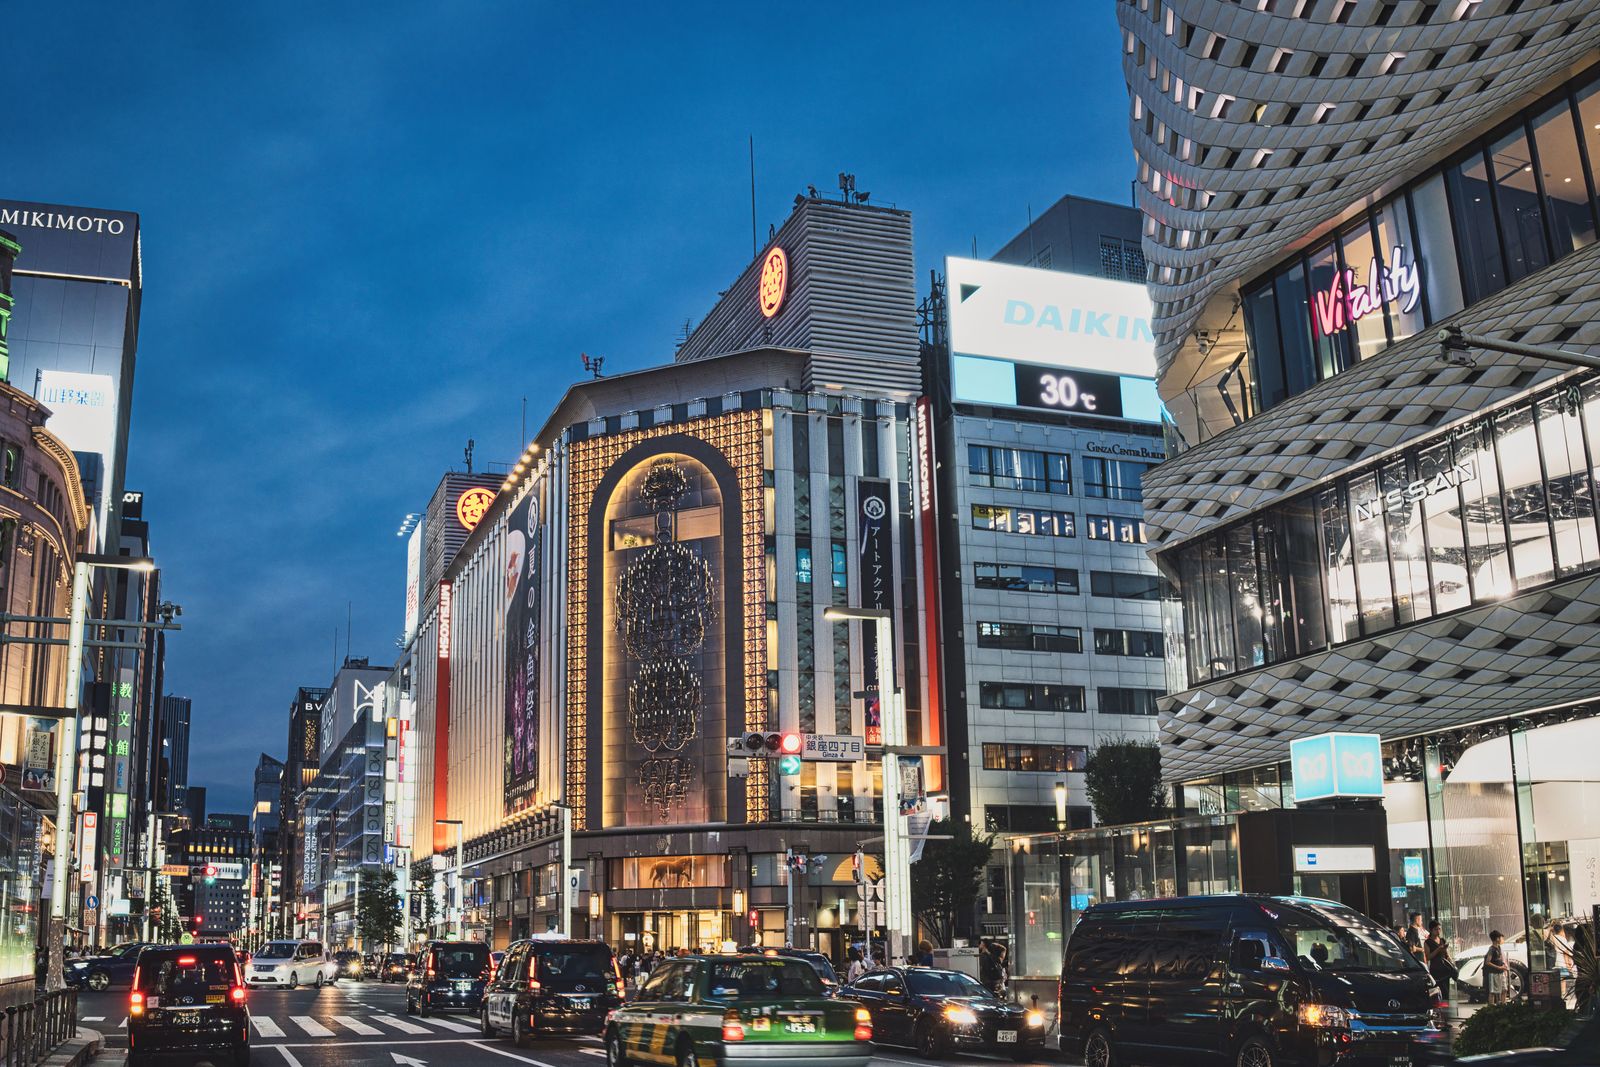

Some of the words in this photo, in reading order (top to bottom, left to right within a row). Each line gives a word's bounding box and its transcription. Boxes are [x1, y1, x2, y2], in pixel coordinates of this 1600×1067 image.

[0, 208, 124, 235] MIKIMOTO
[1317, 246, 1420, 336] Vitality
[918, 404, 931, 512] MITSUKOSHI
[1355, 460, 1477, 523] NISSAN
[436, 584, 451, 658] MITSUKOSHI
[116, 682, 132, 757] 教文館
[806, 740, 860, 753] 銀座四丁目
